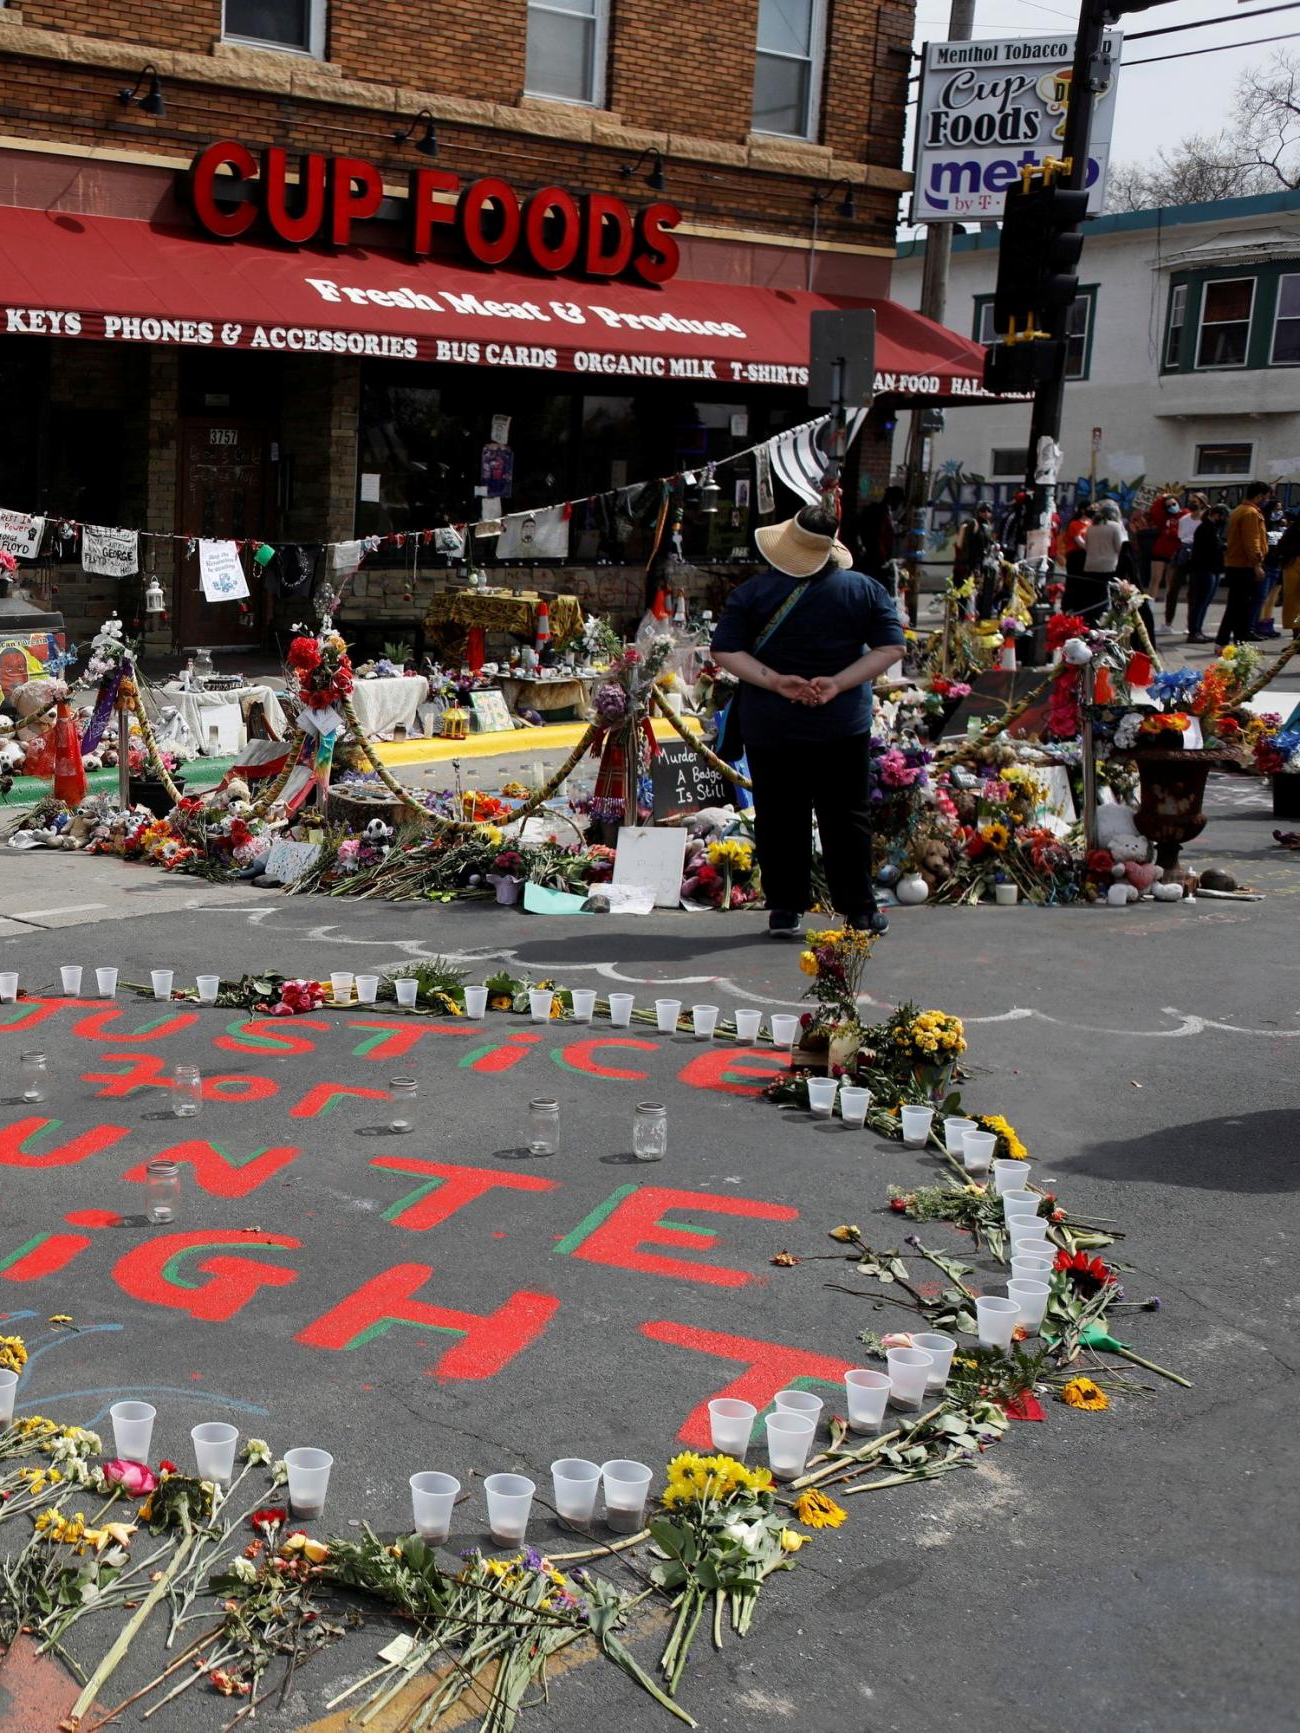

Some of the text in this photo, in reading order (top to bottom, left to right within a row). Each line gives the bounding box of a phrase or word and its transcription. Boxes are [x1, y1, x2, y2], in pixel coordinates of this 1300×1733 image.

[937, 42, 1068, 65] Menthol Tobacco
[941, 70, 1037, 114] Cup
[928, 107, 1040, 145] Foods
[193, 140, 683, 284] CUP FOODS
[304, 277, 747, 340] Fresh Meat & Produce
[5, 307, 82, 335] KEYS
[103, 315, 214, 345] PHONES
[221, 324, 243, 345] &
[251, 326, 419, 360] ACCESSORIES
[435, 340, 480, 365] BUS
[485, 344, 558, 369] CARDS
[573, 350, 665, 377] ORGANIC
[669, 356, 717, 380] MILK
[730, 362, 809, 385] T-SHIRTS
[899, 375, 940, 394] FOOD
[211, 430, 237, 444] 3757
[0, 540, 30, 555] FLOYD
[102, 547, 133, 562] GEORGE
[657, 746, 698, 765] Murder
[677, 766, 722, 785] A Badge
[676, 783, 726, 804] Is Still
